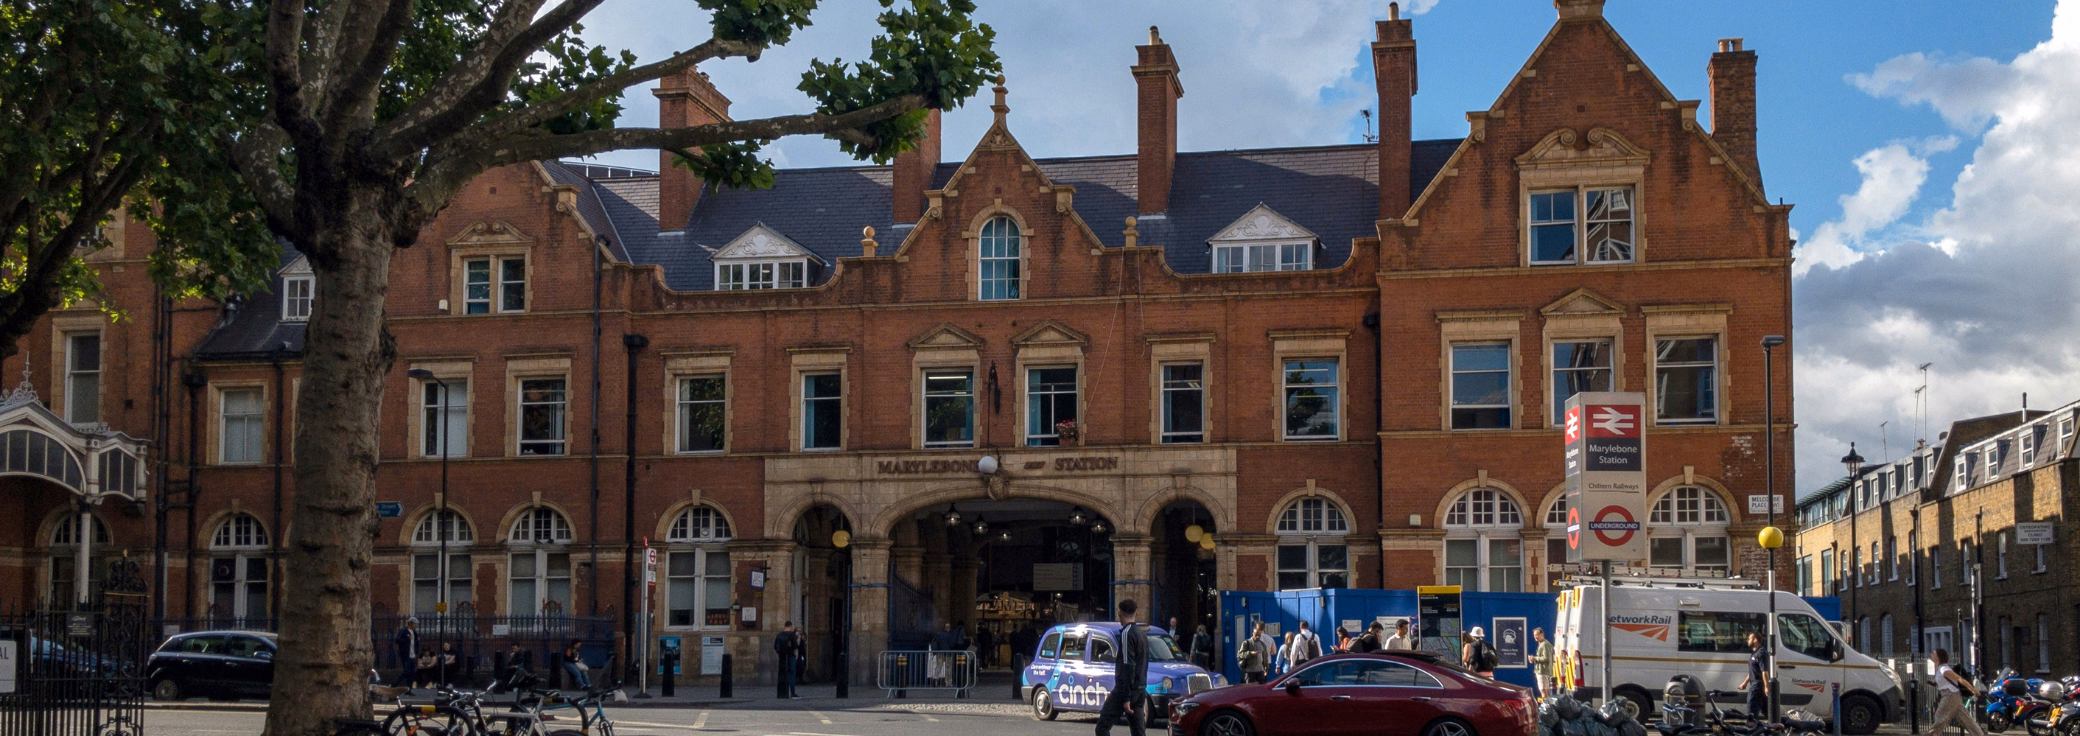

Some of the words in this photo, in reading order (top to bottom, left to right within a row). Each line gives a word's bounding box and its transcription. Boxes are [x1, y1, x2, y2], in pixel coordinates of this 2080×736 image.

[1589, 445, 1637, 455] Marylebone
[1055, 457, 1118, 471] STATION
[1599, 456, 1628, 464] Station
[1588, 482, 1611, 490] Chiltern
[1613, 482, 1639, 491] Railways
[1609, 615, 1672, 624] etworkRail
[1059, 675, 1108, 706] cinch
